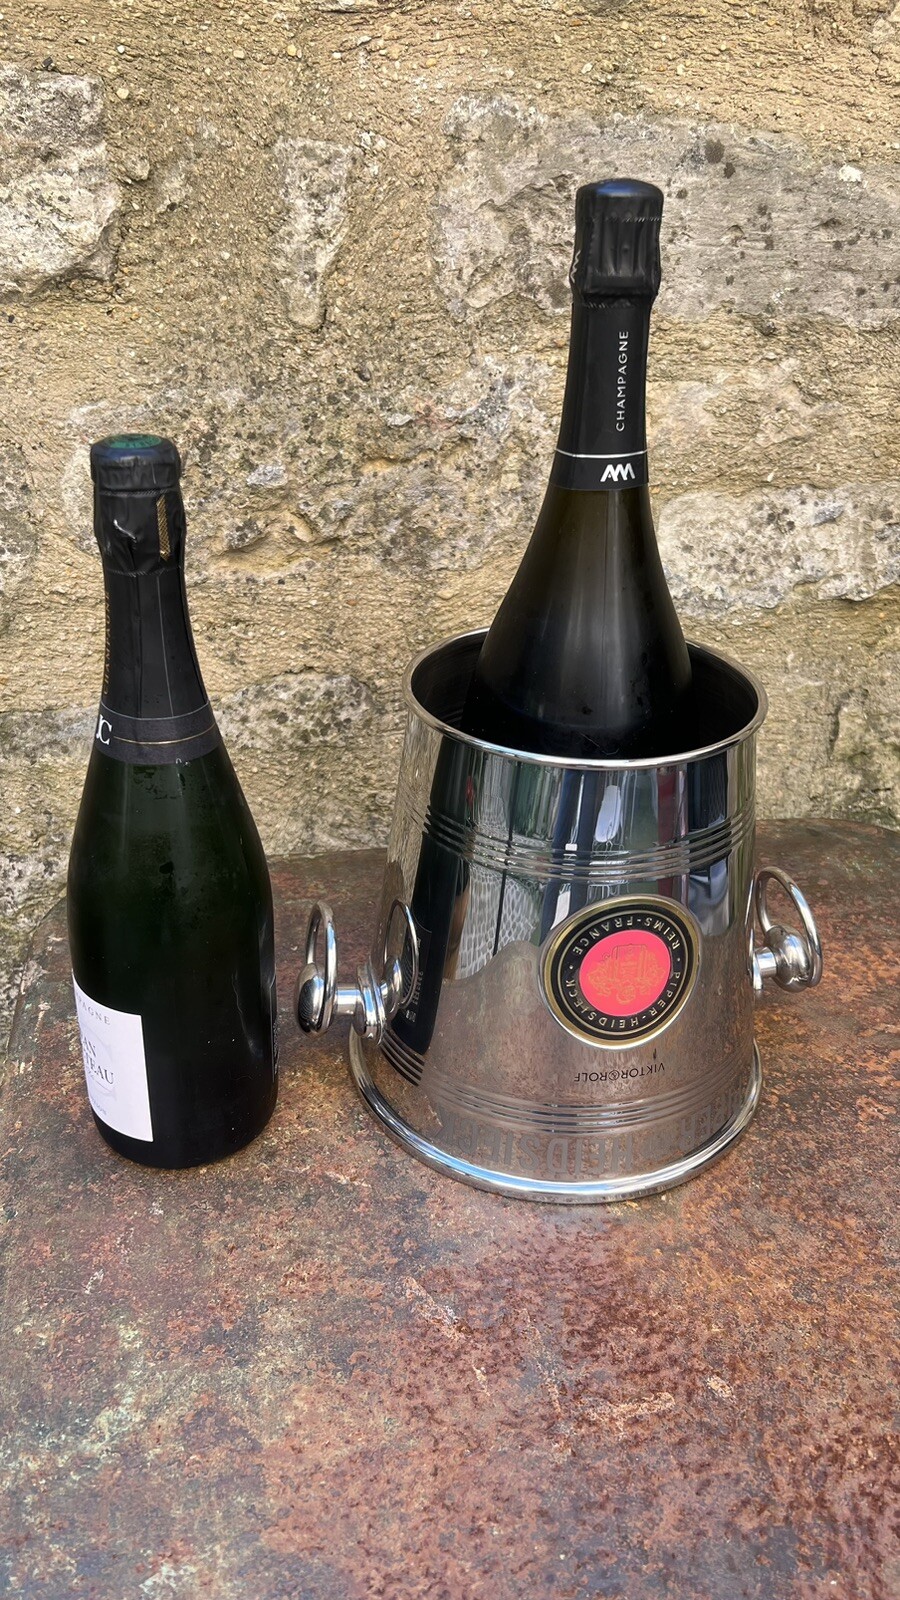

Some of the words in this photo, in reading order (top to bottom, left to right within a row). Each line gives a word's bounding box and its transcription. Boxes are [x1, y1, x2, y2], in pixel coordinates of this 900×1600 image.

[616, 331, 629, 432] CHAMPAGNE
[572, 916, 681, 955] REIMS-FRANCE
[565, 972, 681, 1028] PIPER-HEIDSIECK
